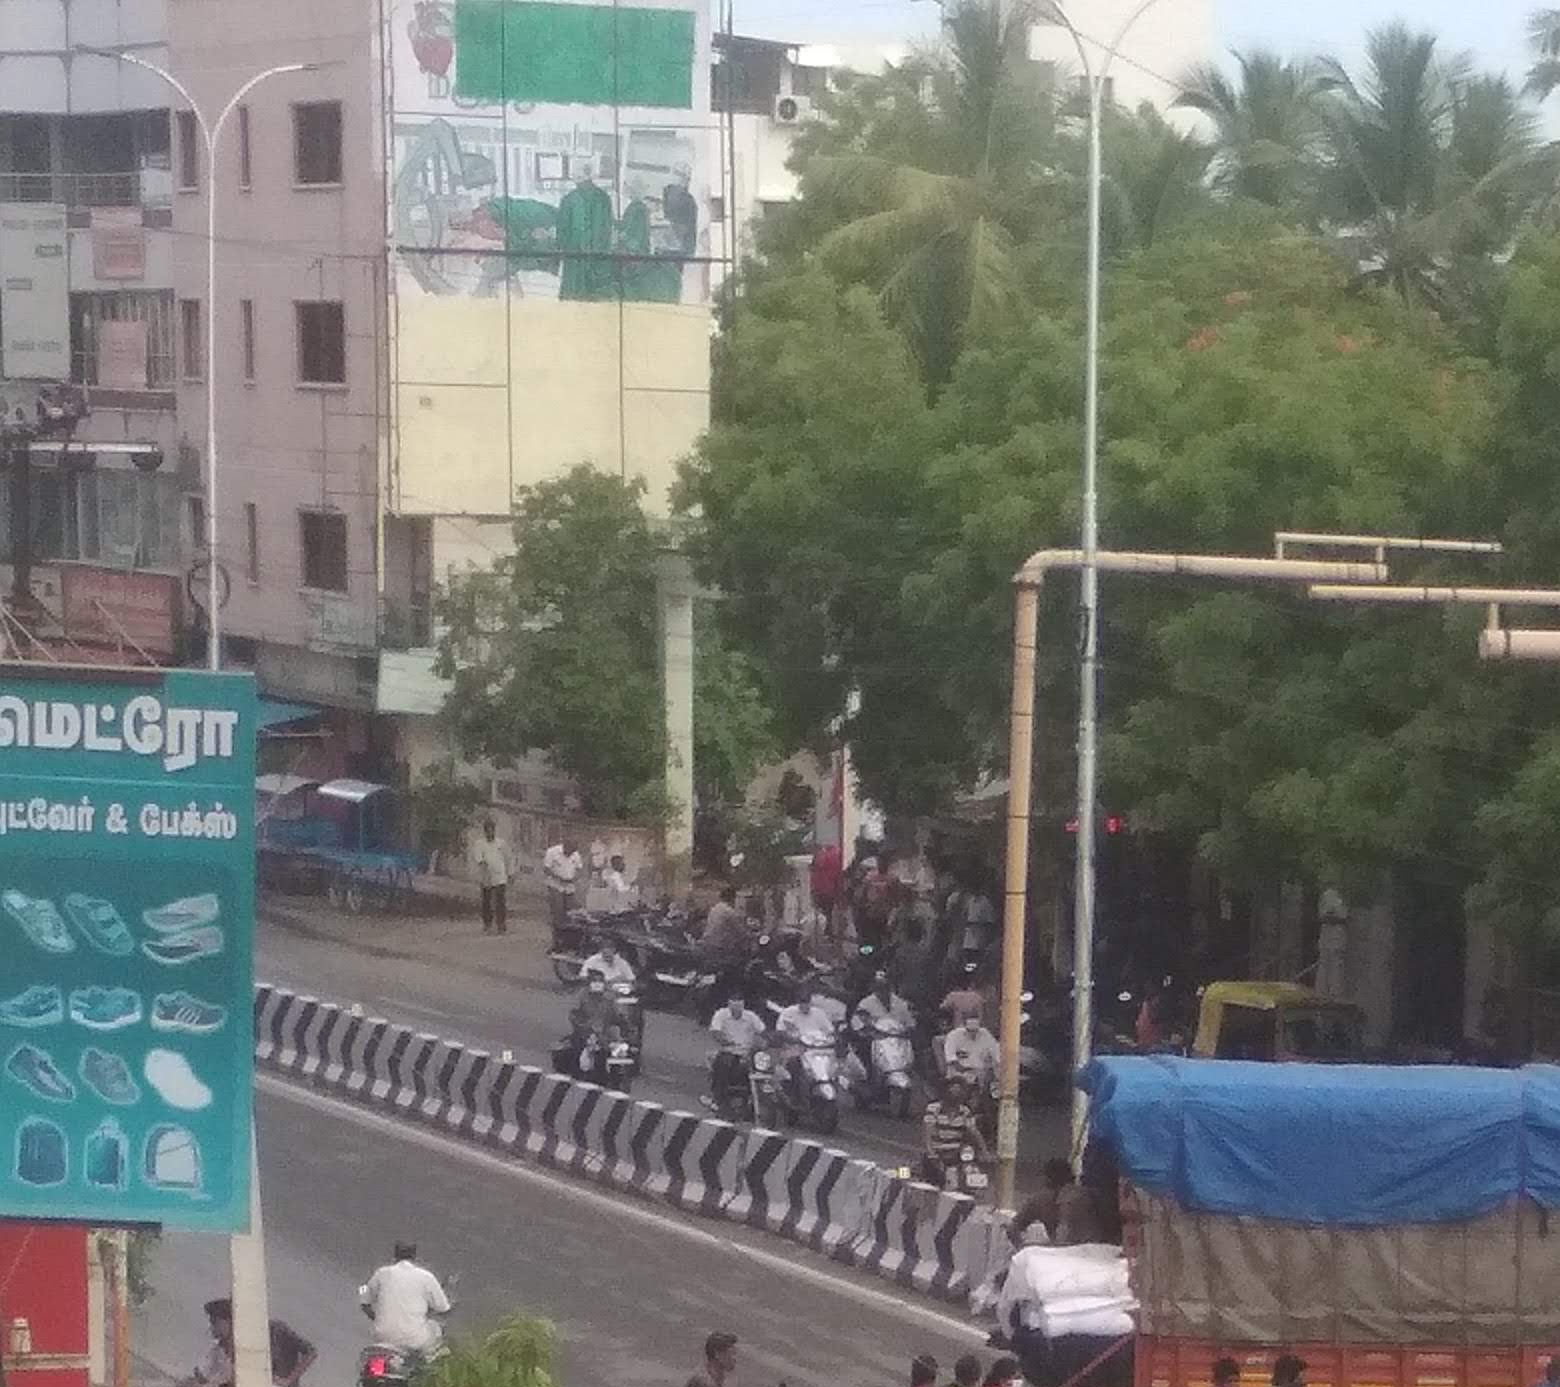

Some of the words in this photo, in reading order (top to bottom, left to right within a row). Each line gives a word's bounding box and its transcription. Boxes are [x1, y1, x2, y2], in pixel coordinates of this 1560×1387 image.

[0, 695, 239, 773] மெட்ரோ
[106, 803, 128, 834] &
[140, 801, 237, 839] பேக்ஸ்
